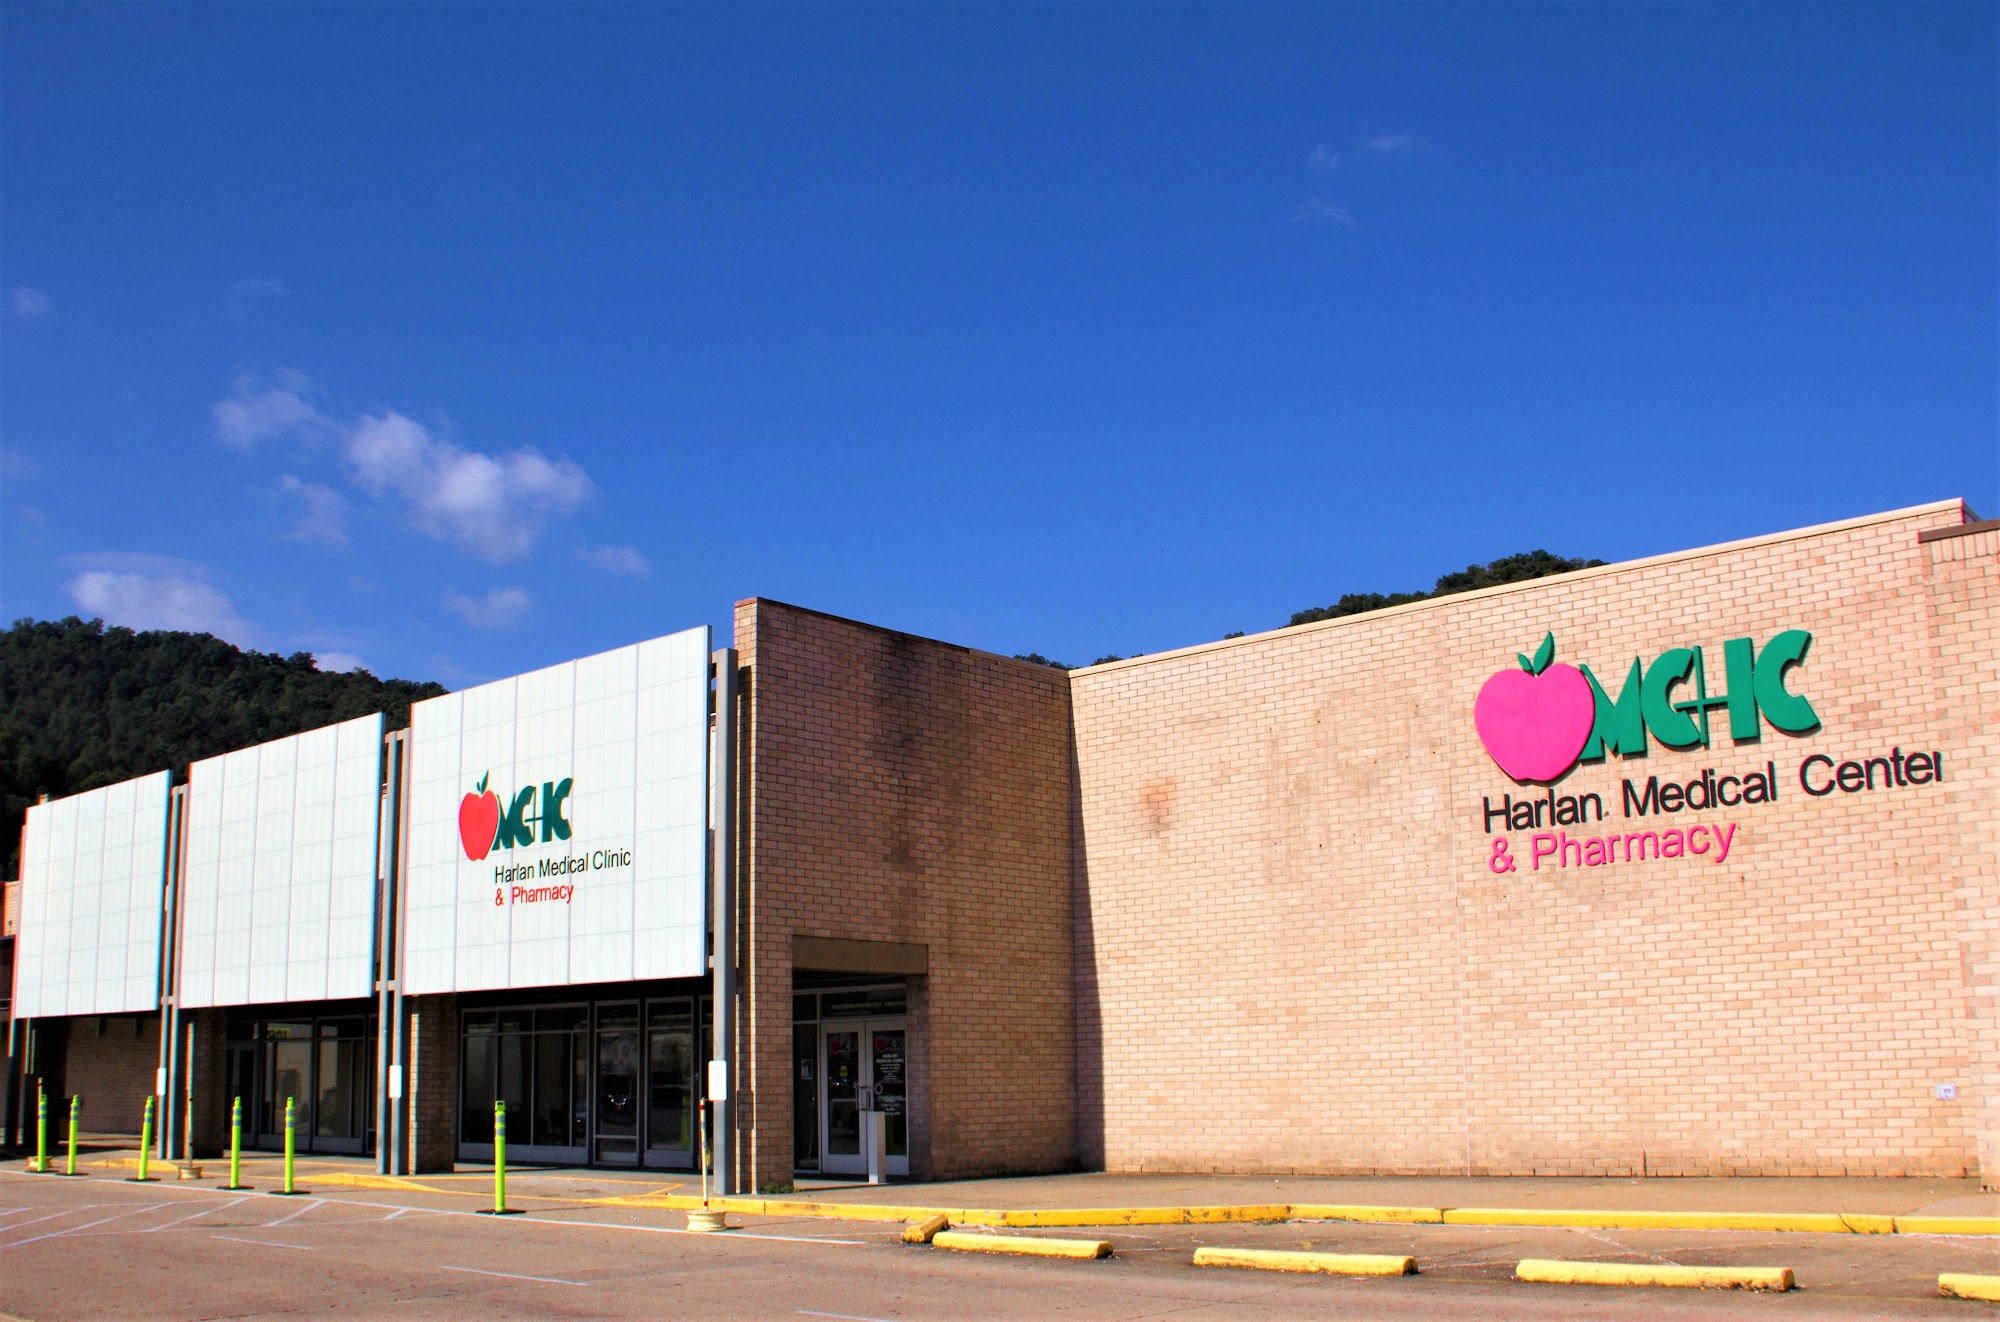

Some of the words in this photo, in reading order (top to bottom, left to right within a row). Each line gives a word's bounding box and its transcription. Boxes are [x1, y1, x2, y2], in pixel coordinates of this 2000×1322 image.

[1483, 788, 1604, 834] Harlan
[1622, 761, 1778, 818] Medical
[495, 863, 535, 884] Harlan
[539, 852, 589, 878] Medical
[592, 847, 632, 871] Clinic
[1489, 836, 1517, 874] &
[1531, 821, 1738, 871] Pharmacy
[494, 887, 504, 907] &
[511, 884, 574, 905] Pharmacy
